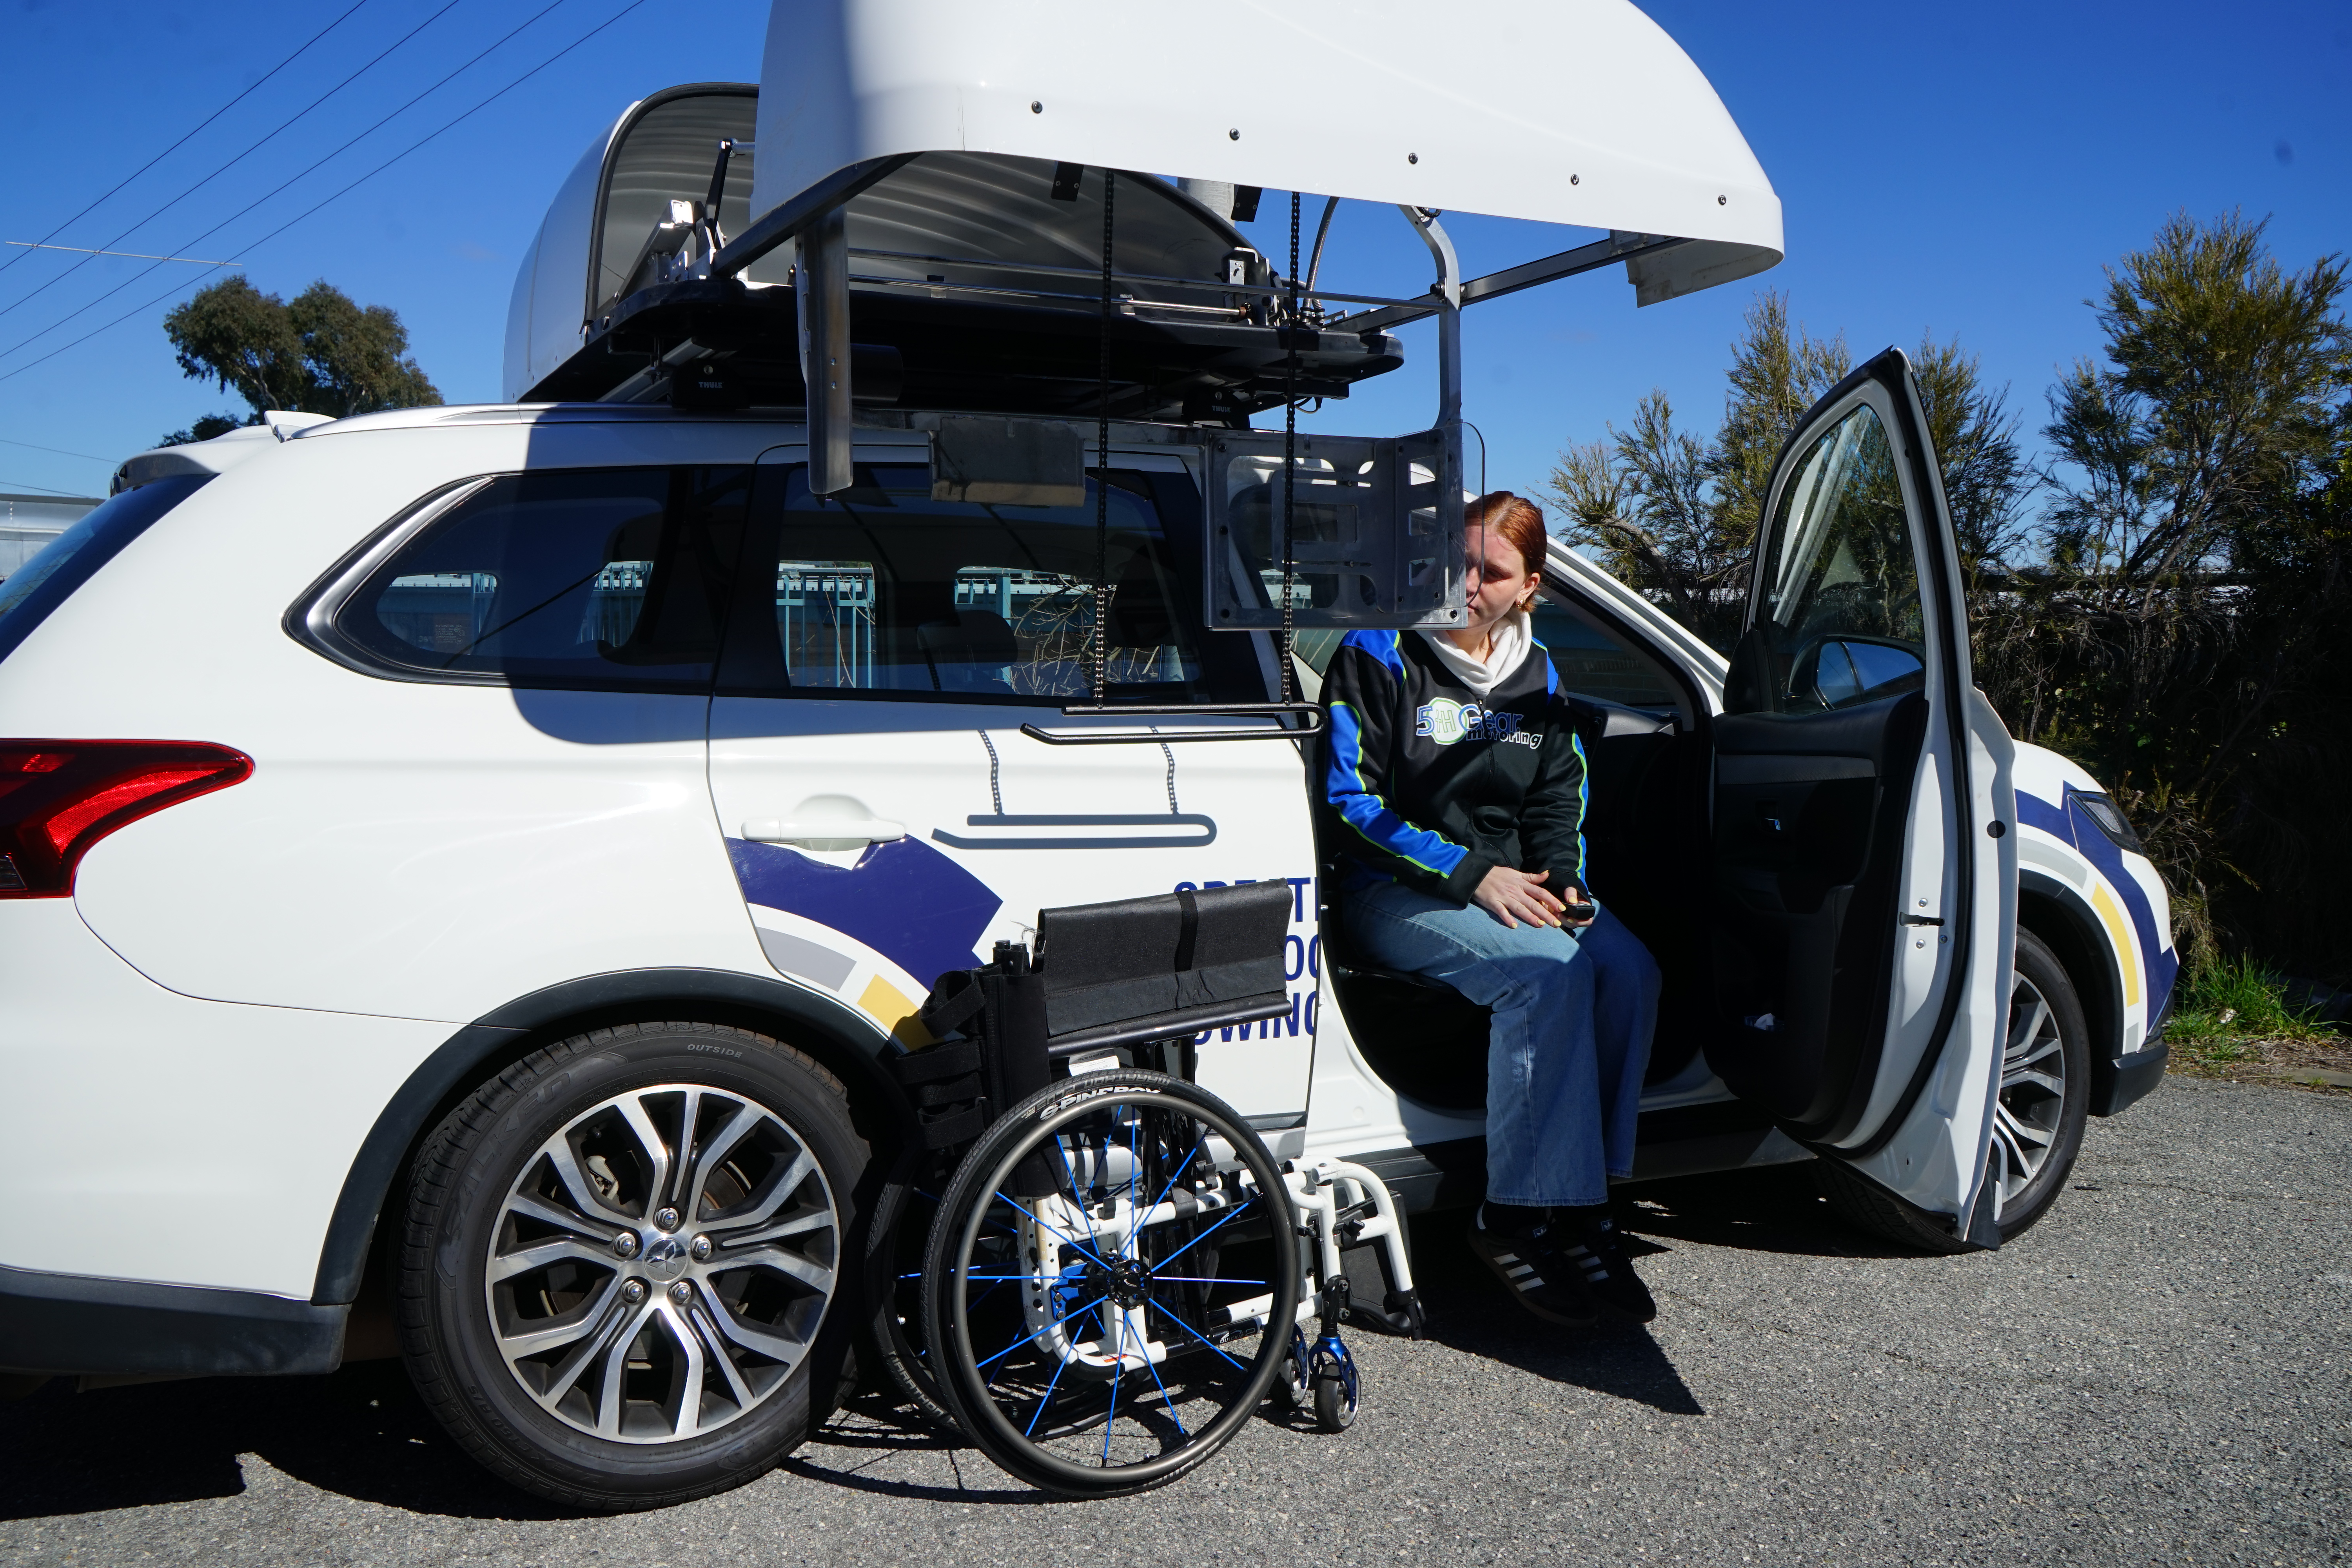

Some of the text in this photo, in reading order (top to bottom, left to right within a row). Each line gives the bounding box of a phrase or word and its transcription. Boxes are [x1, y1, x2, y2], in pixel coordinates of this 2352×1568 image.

[1458, 704, 1524, 734] Gear
[1466, 727, 1543, 750] motoring
[687, 1044, 743, 1058] OUTSIDE
[1037, 1074, 1170, 1110] MARATHON PLUS
[1220, 1334, 1244, 1344] QUICKIE
[889, 1351, 944, 1417] MARATHON
[490, 1418, 531, 1451] CT60
